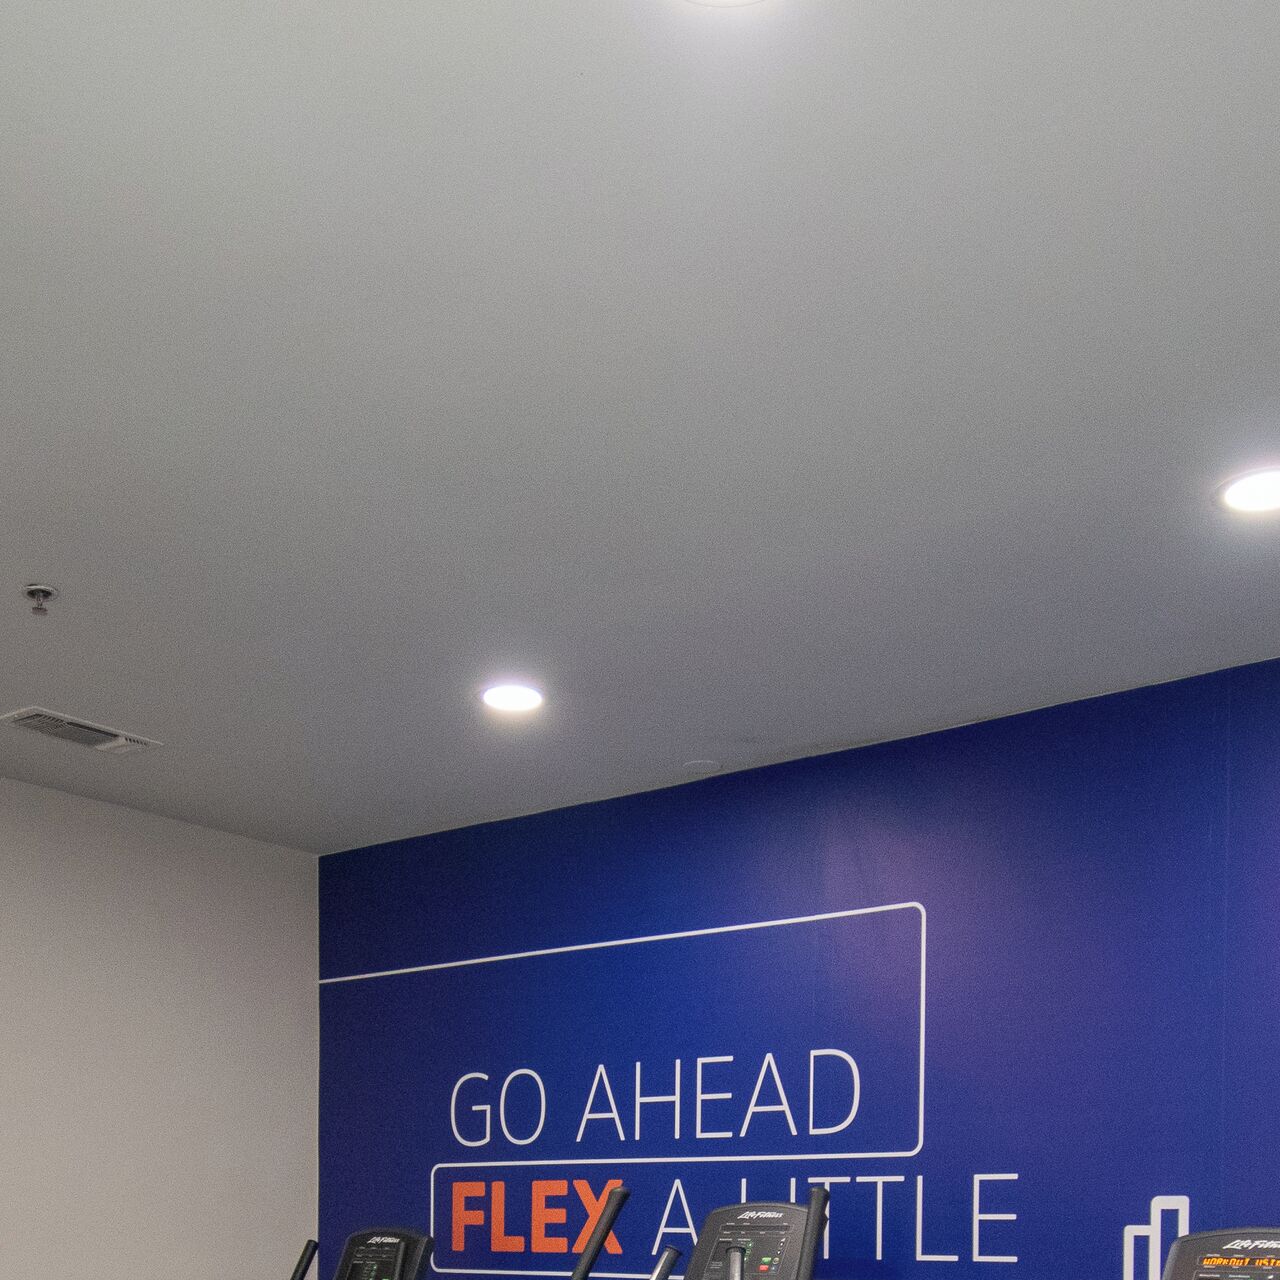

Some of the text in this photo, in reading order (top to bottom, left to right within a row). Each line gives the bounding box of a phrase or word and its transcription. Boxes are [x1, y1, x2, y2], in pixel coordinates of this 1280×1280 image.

[450, 1048, 862, 1148] GO AHEAD
[451, 1179, 624, 1255] FLEX
[1203, 1257, 1250, 1266] WORKOUT
